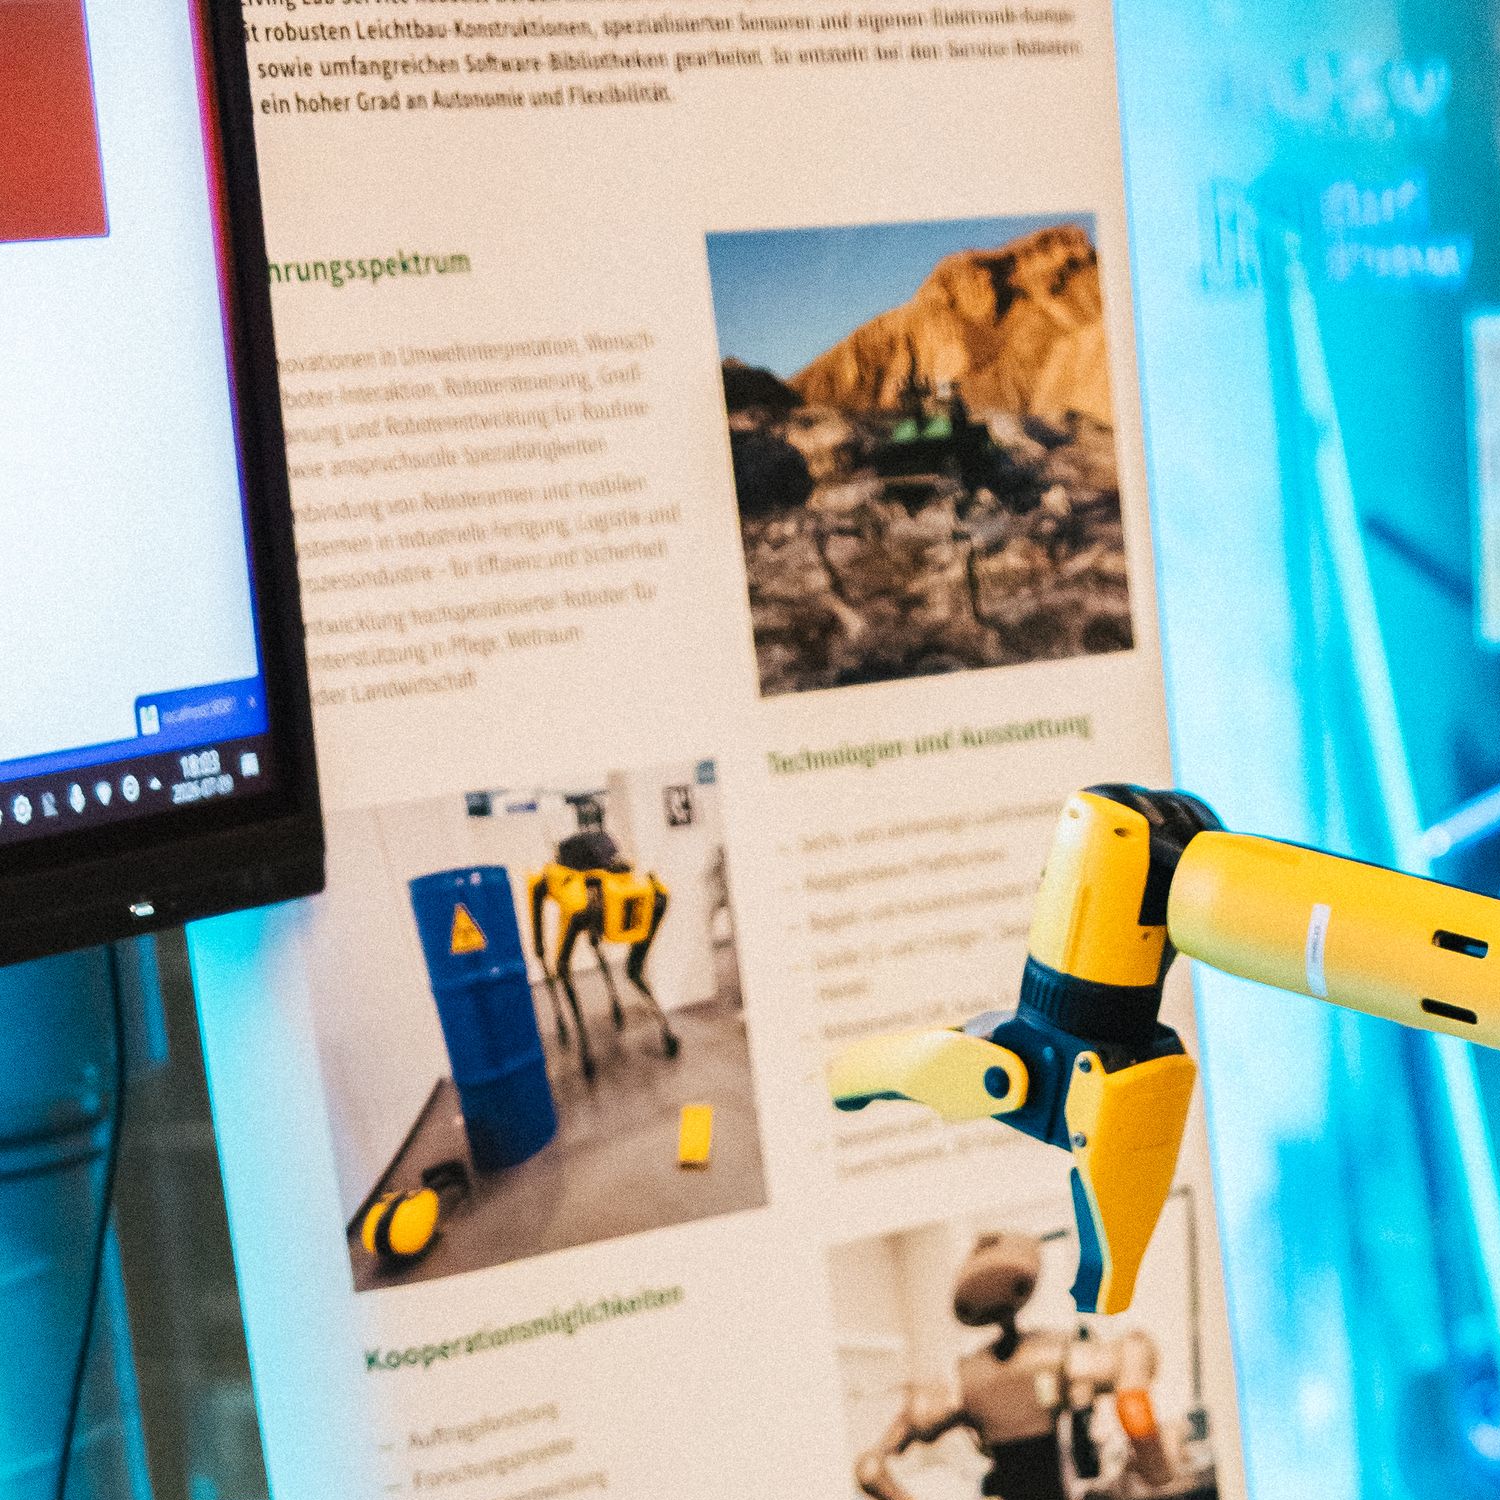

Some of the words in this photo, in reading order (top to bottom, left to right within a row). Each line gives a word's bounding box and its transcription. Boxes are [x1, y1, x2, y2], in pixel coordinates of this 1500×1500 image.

[264, 21, 350, 42] robusten
[258, 56, 313, 79] sowie
[320, 54, 459, 81] umfangreichen
[260, 93, 291, 115] ein
[294, 90, 352, 114] hoher
[356, 89, 401, 112] Grad
[405, 92, 428, 110] an
[433, 87, 524, 110] Autonomie
[528, 86, 563, 108] und
